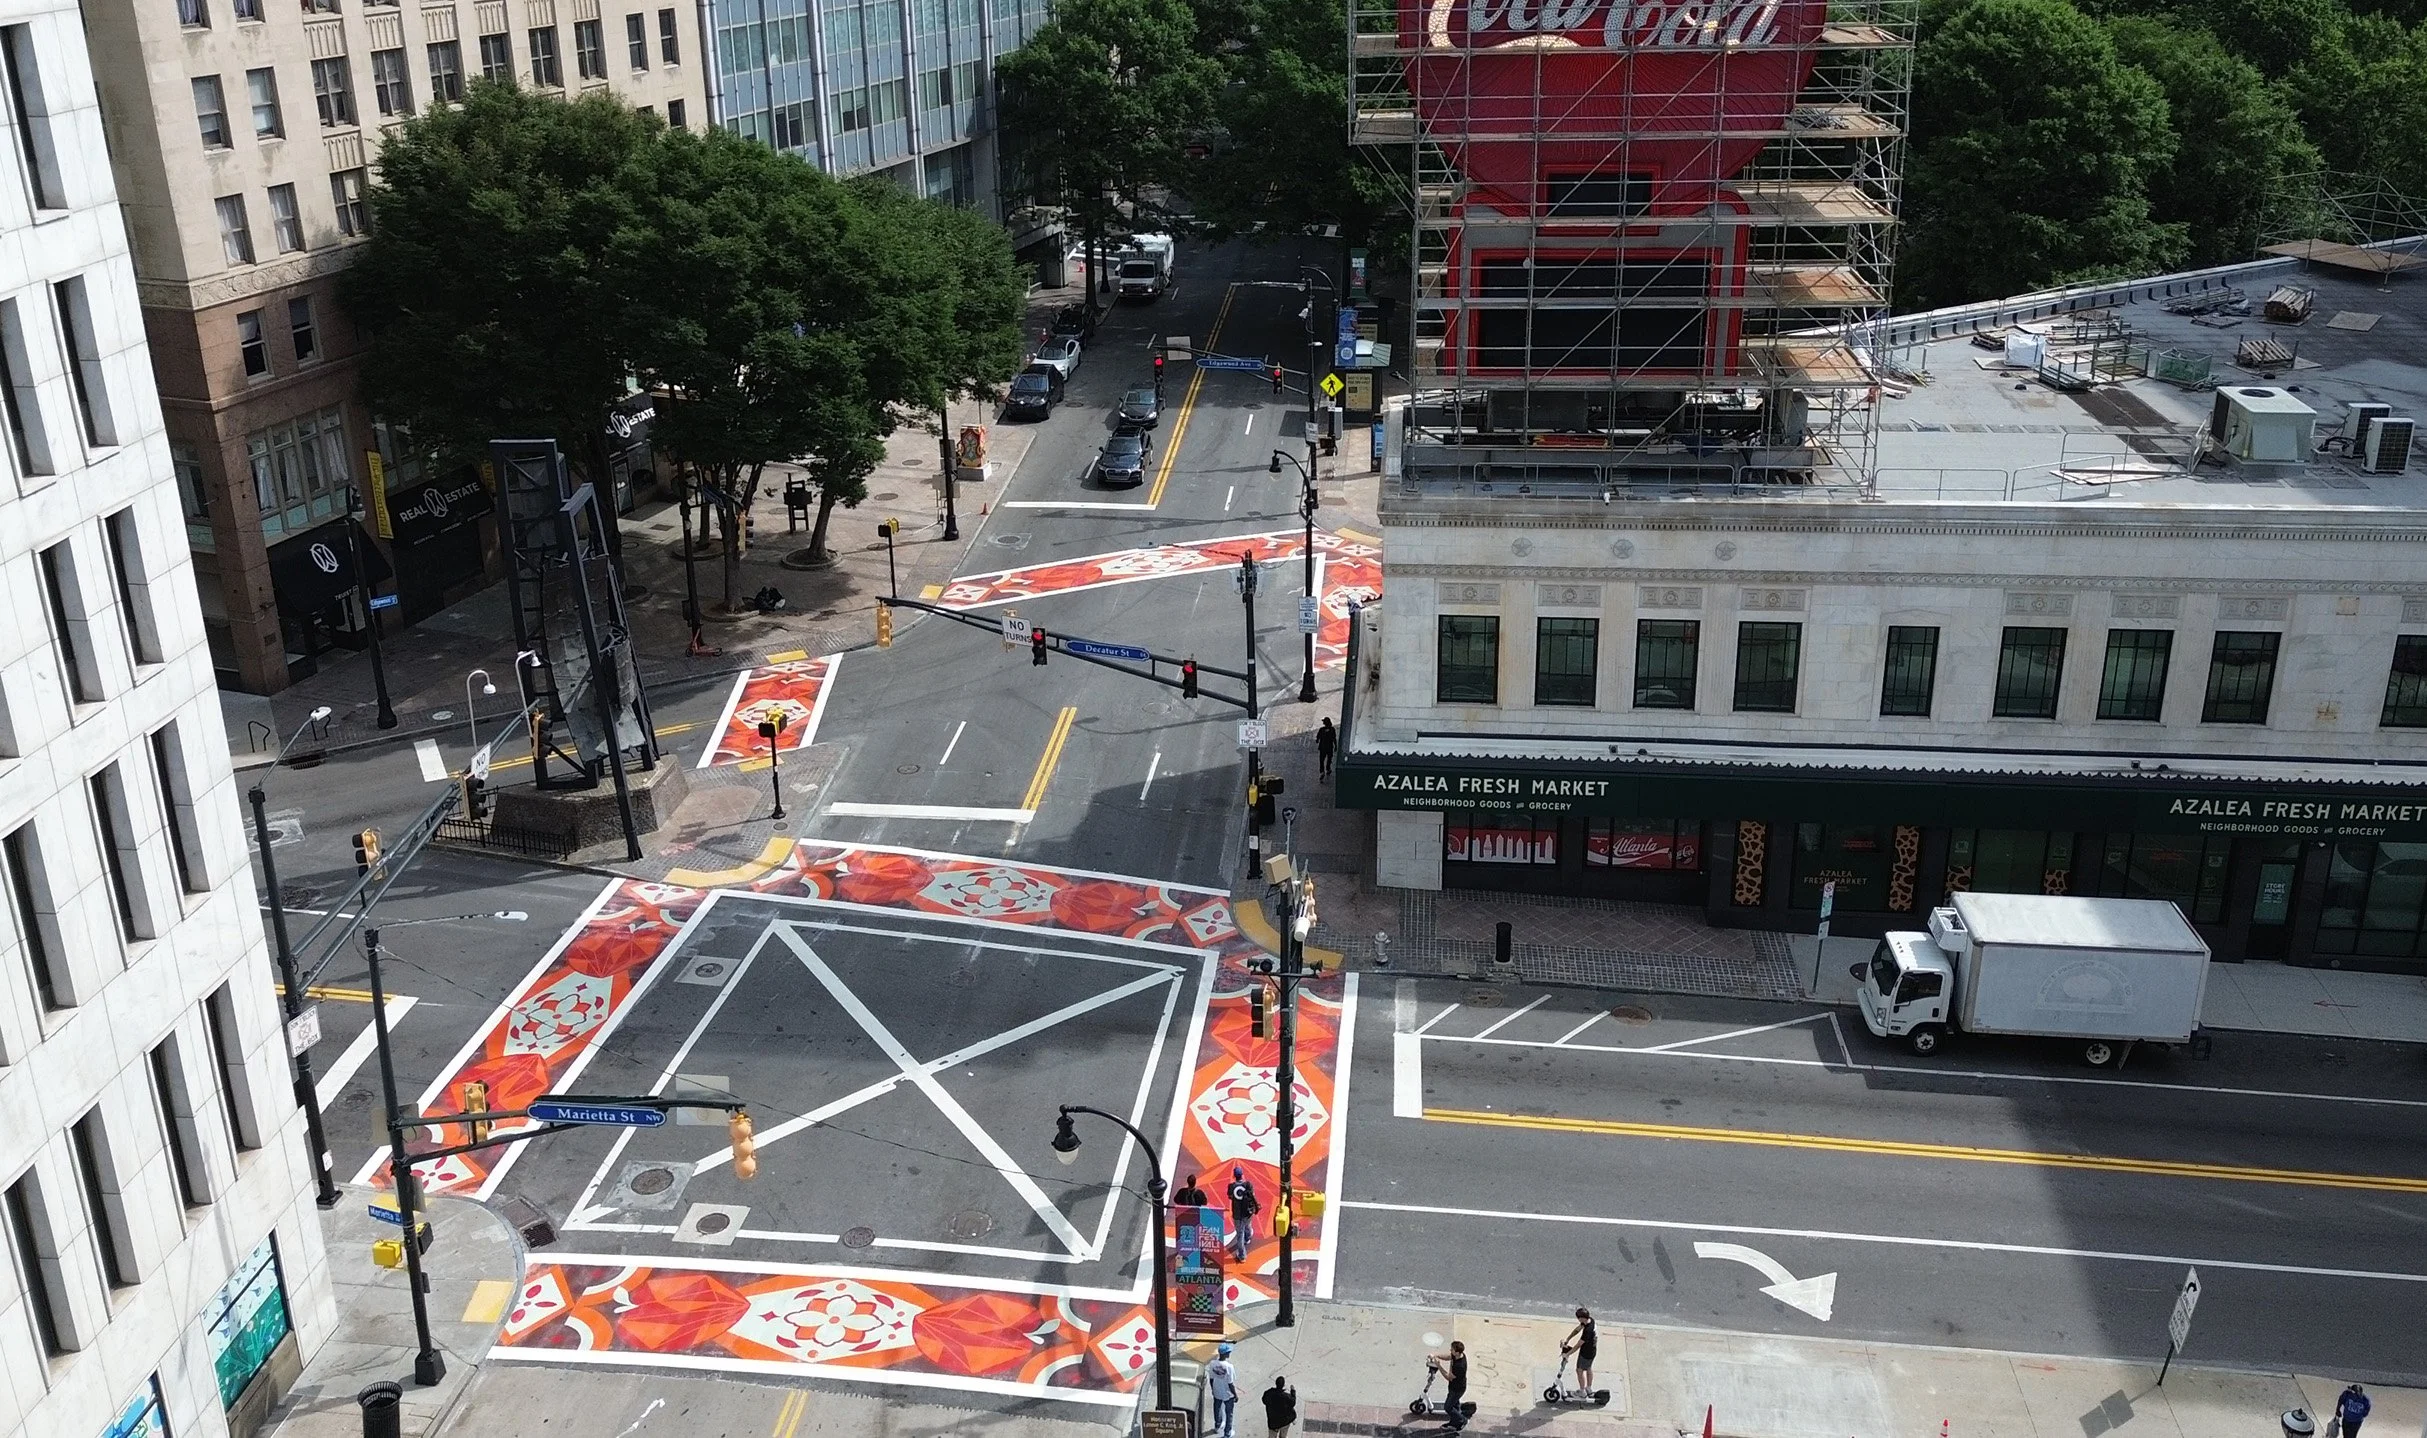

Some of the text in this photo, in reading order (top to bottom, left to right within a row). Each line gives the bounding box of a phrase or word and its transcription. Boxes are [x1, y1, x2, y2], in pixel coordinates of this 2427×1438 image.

[399, 481, 480, 523] REAL ESTATE
[1009, 620, 1025, 631] NO
[1005, 631, 1032, 644] TURNS
[1085, 644, 1120, 656] Decatur
[1121, 649, 1130, 657] St
[1374, 775, 1609, 796] AZALEA FRESH MARKET
[1403, 797, 1476, 808] NEIGHBORHOOD
[1479, 800, 1511, 809] GOODS
[1529, 801, 1572, 810] GROCERY
[2170, 799, 2427, 822] AZALEA FRESH MARKET
[2200, 822, 2279, 833] NEIGHBORHOOD
[2284, 825, 2319, 834] GOODS
[2338, 826, 2386, 836] GROCERY
[1819, 870, 1852, 878] AZALEA
[1803, 877, 1868, 886] FRESH MARKET
[557, 1108, 616, 1121] Marietta
[620, 1111, 635, 1122] St
[1179, 1275, 1222, 1284] ATLANTA
